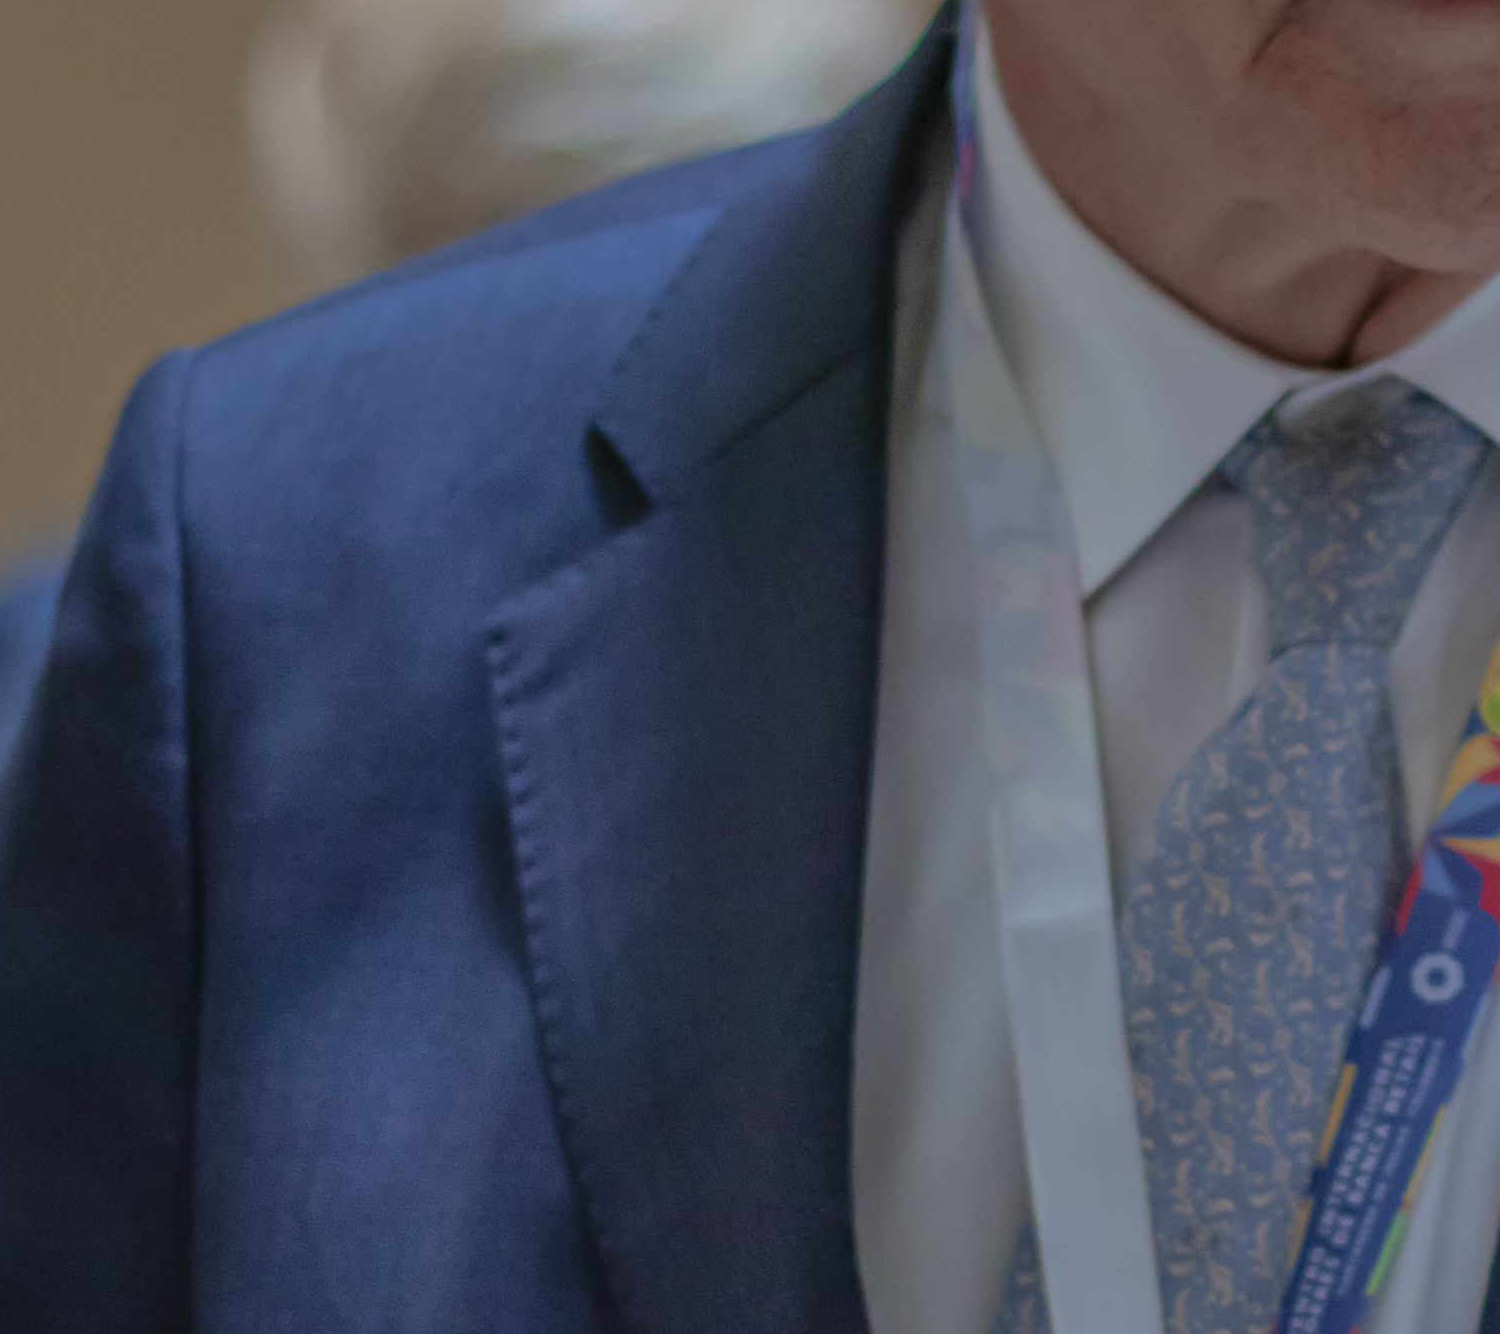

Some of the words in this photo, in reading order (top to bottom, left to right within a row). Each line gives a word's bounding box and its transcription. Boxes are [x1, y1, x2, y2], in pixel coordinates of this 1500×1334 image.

[1315, 1038, 1403, 1237] INTERNACIONAL
[1330, 1213, 1356, 1248] DE
[1345, 1121, 1392, 1207] BANCA
[1381, 1033, 1426, 1116] RETAIL
